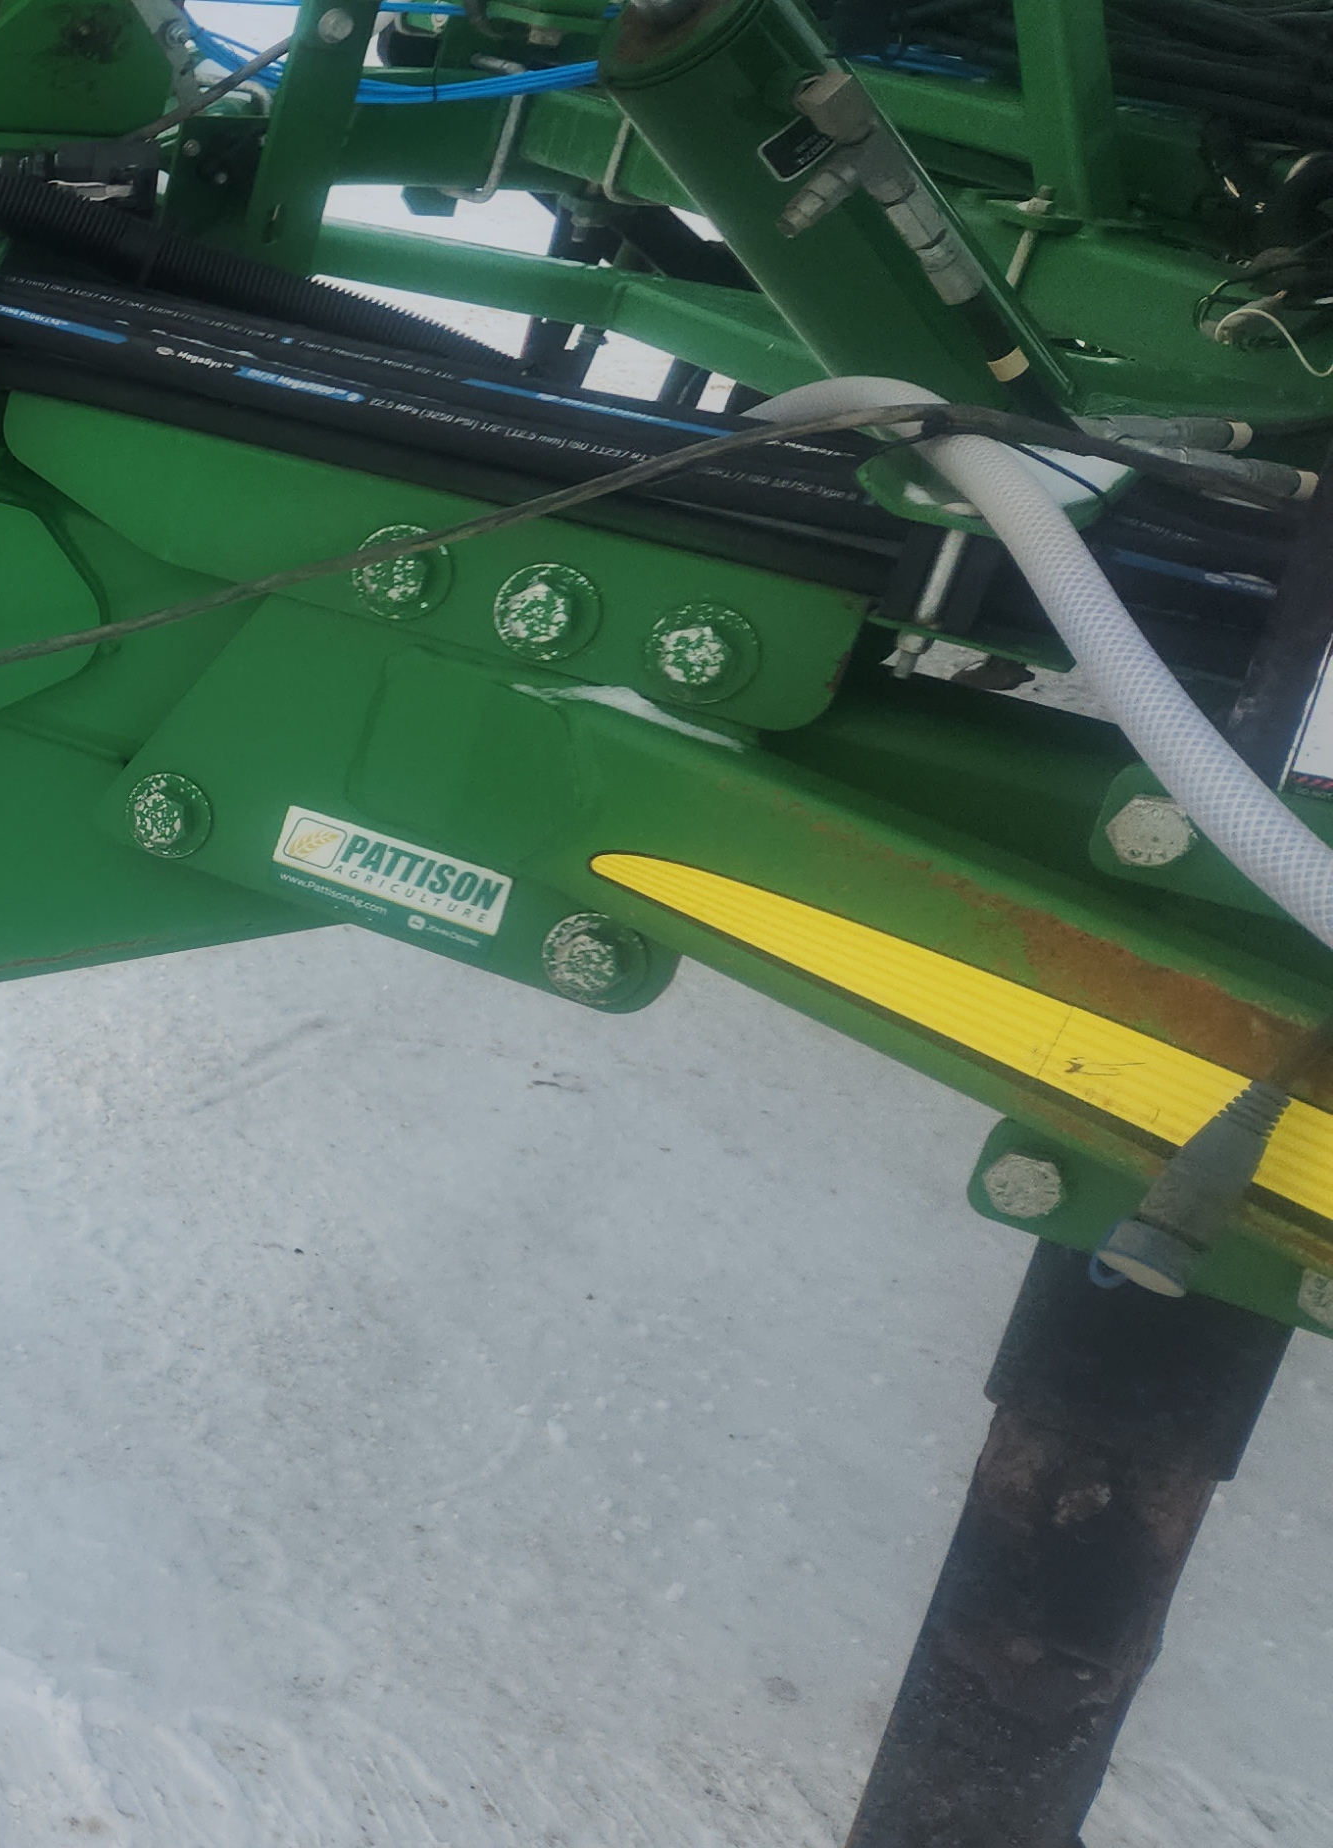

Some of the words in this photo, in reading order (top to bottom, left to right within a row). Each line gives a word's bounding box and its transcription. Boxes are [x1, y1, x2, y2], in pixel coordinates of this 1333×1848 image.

[279, 872, 387, 916] www.PattisonAg.com
[332, 865, 489, 924] AGRICULTURE
[339, 833, 504, 912] PATTISON
